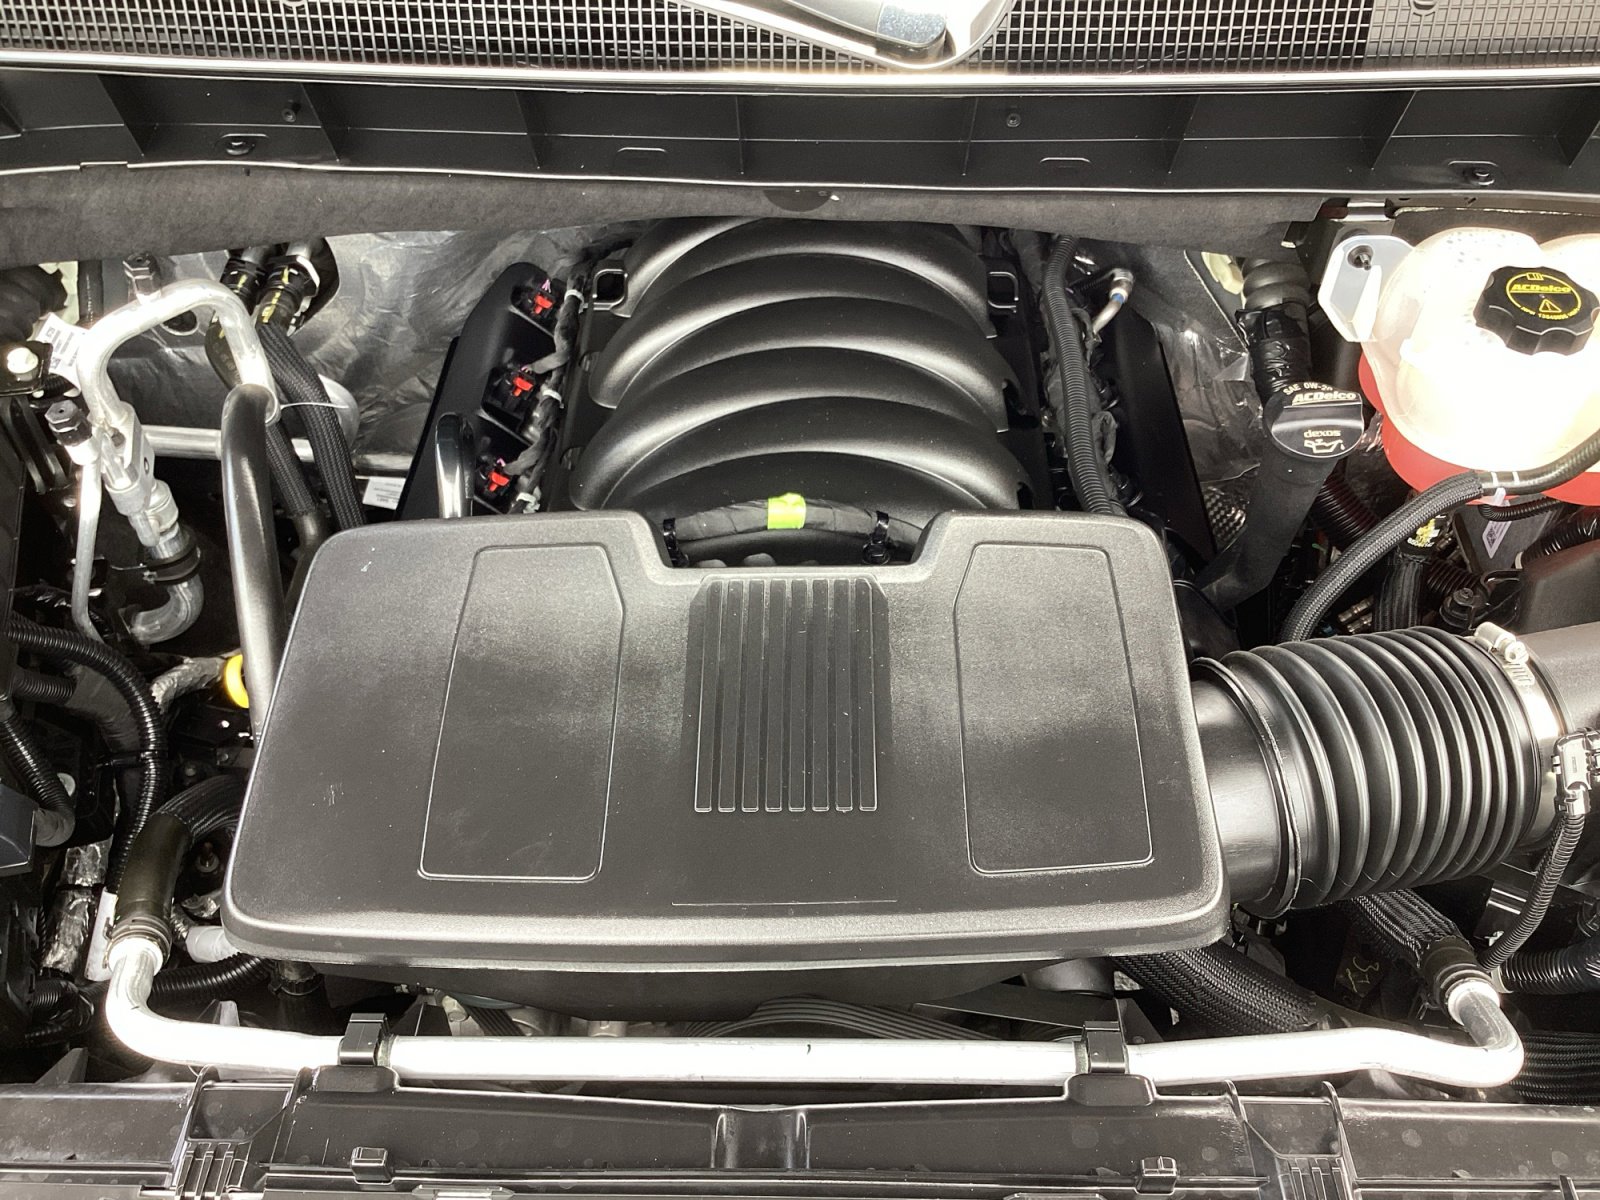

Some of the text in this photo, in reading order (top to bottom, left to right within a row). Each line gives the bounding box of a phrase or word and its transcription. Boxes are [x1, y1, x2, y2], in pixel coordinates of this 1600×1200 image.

[1510, 284, 1571, 293] ACDelco
[1283, 383, 1301, 395] SAE
[1292, 391, 1356, 403] ACDelco
[1303, 429, 1341, 438] dexos
